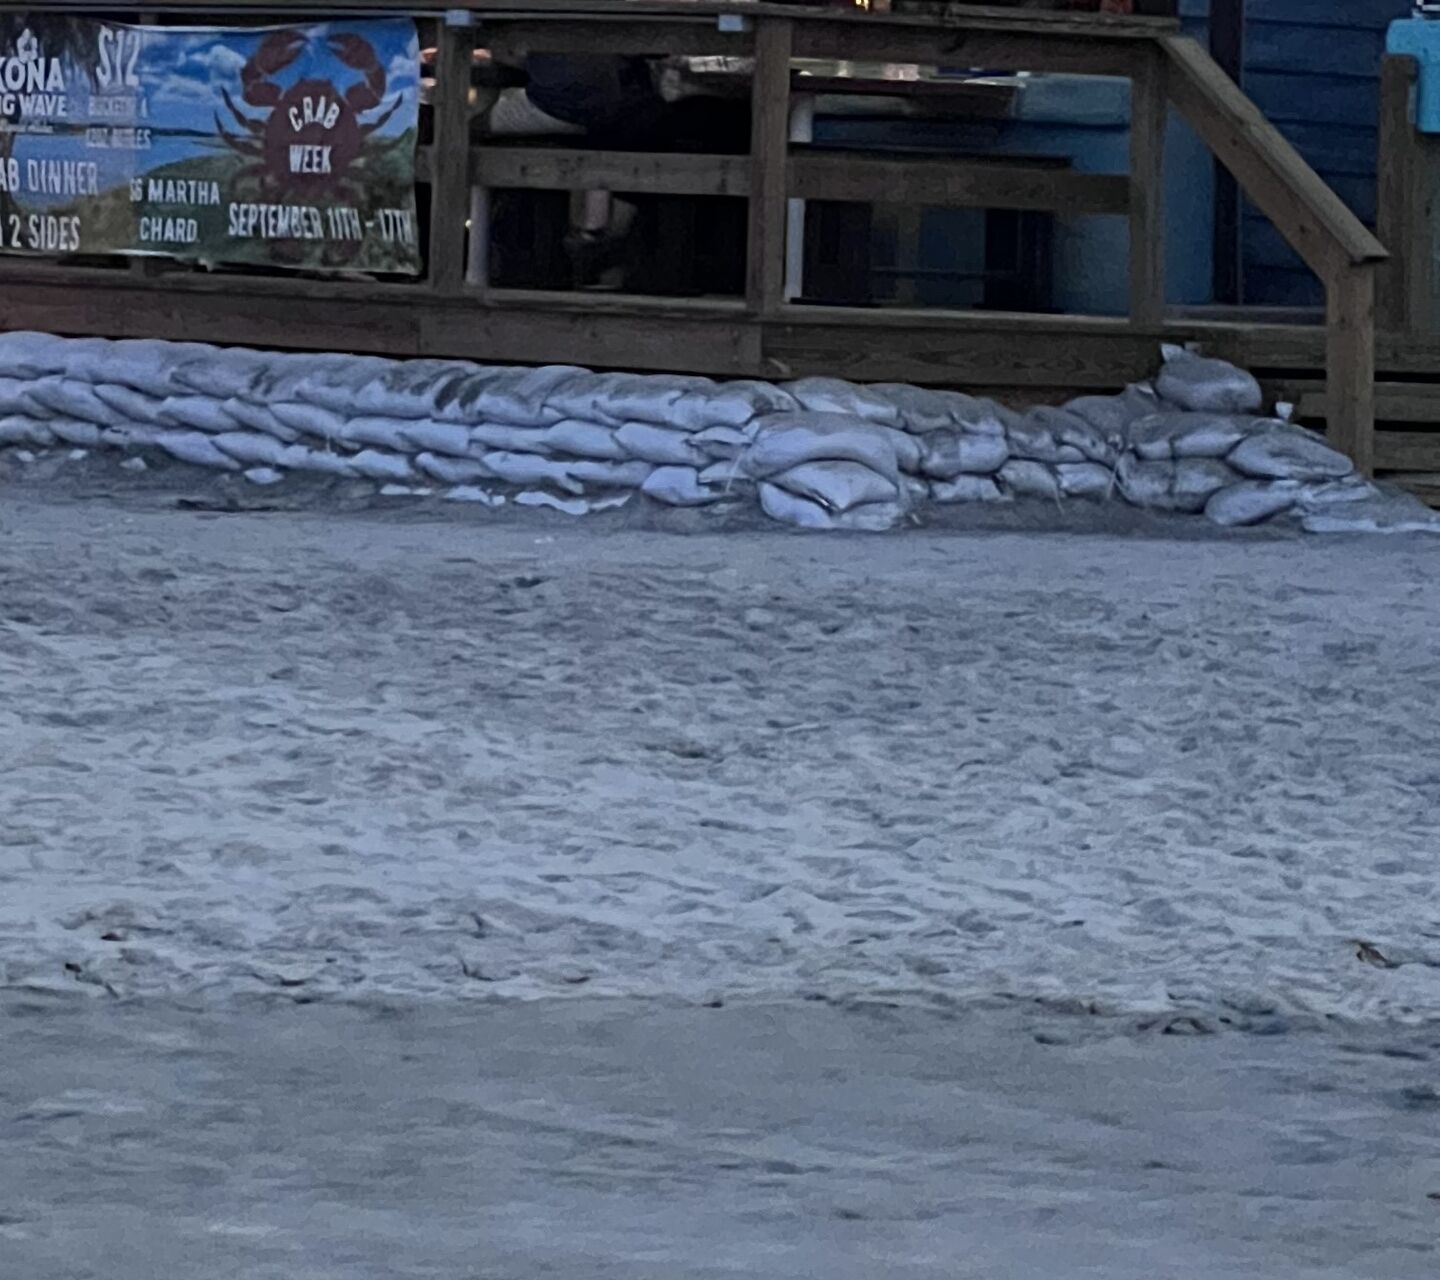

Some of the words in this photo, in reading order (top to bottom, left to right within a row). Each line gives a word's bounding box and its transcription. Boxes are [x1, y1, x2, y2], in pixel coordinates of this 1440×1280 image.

[18, 94, 67, 117] WAVE
[289, 95, 340, 132] CRAB
[289, 144, 332, 174] WEEK
[27, 158, 98, 196] DINNER
[148, 179, 220, 205] MARTHA
[9, 214, 22, 248] 2
[28, 214, 80, 251] SIDES
[140, 216, 198, 243] CHARD
[228, 202, 324, 239] SEPTEMBER
[327, 207, 362, 240] 11TH
